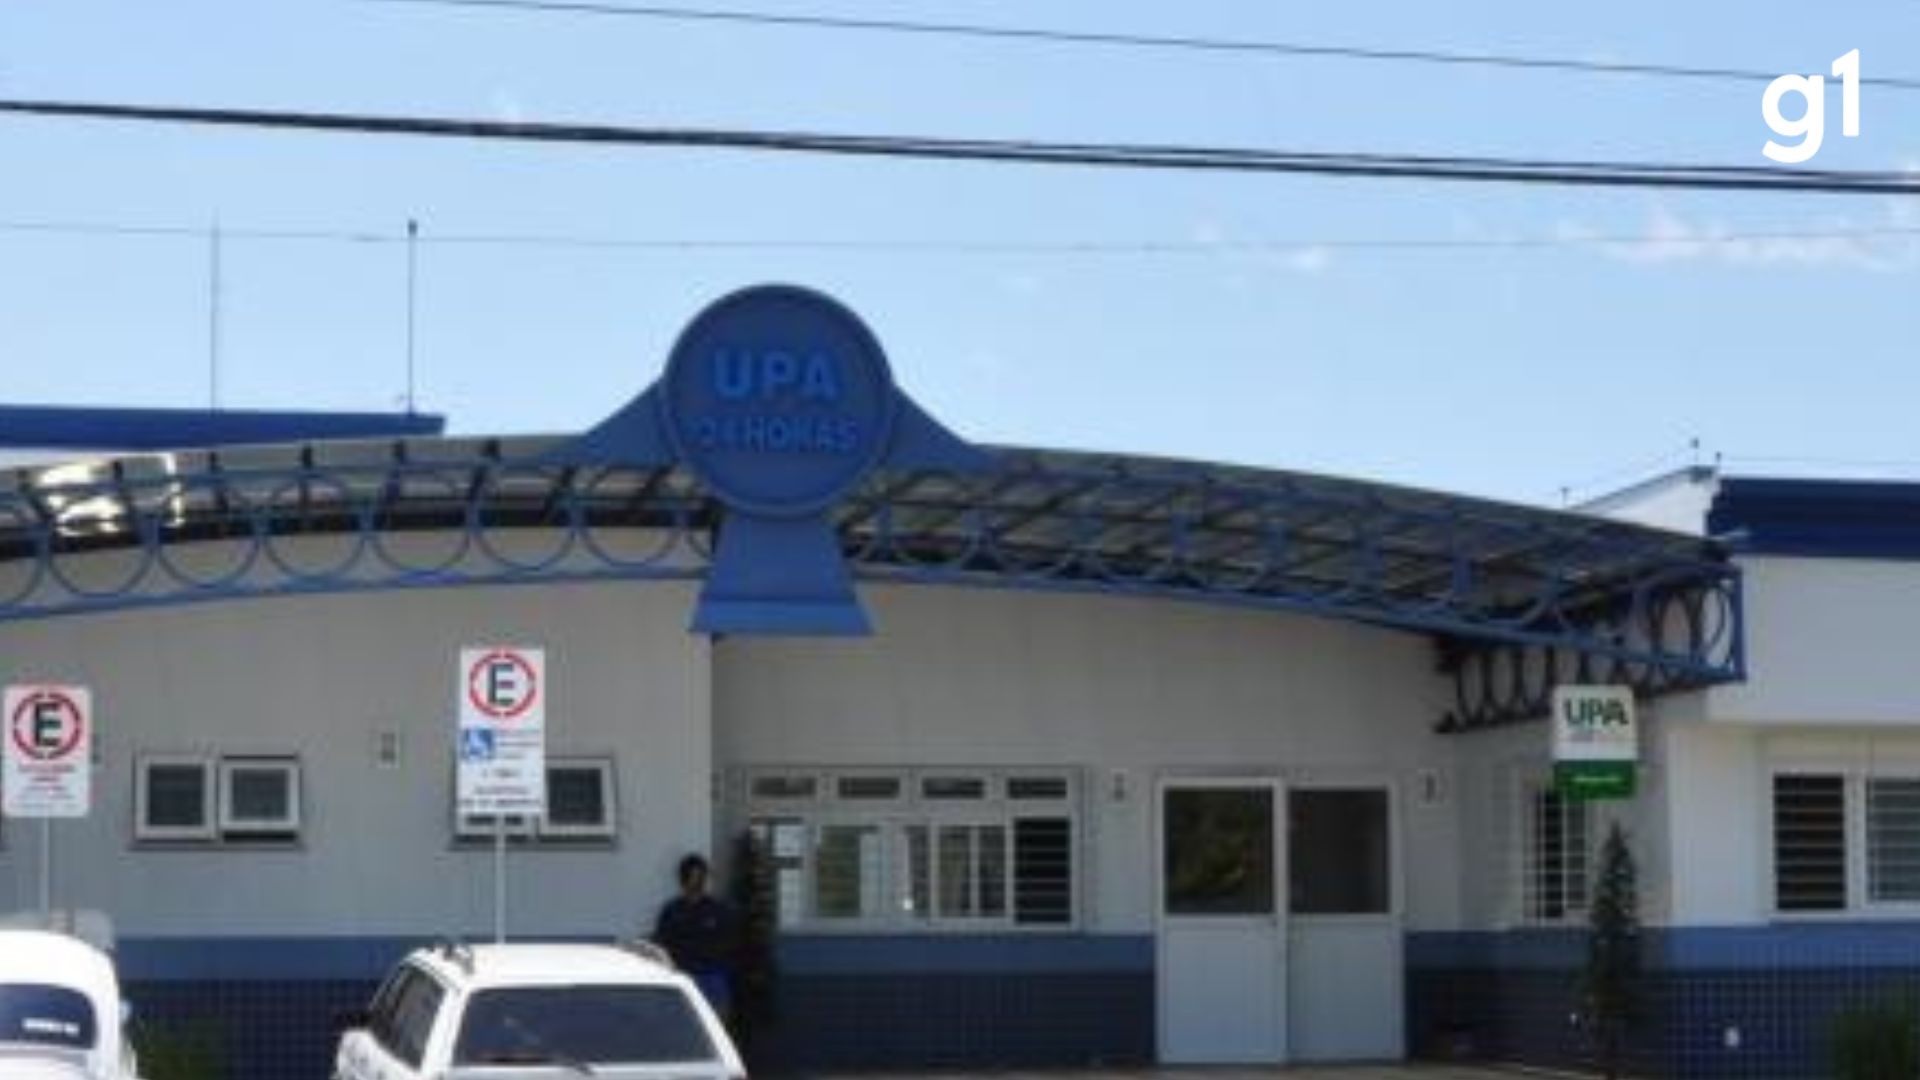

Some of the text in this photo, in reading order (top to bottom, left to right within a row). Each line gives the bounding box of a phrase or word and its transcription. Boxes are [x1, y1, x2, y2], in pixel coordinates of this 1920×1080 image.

[713, 349, 838, 399] UPA
[487, 662, 516, 706] E
[32, 700, 62, 747] E
[1563, 698, 1630, 727] UPA
